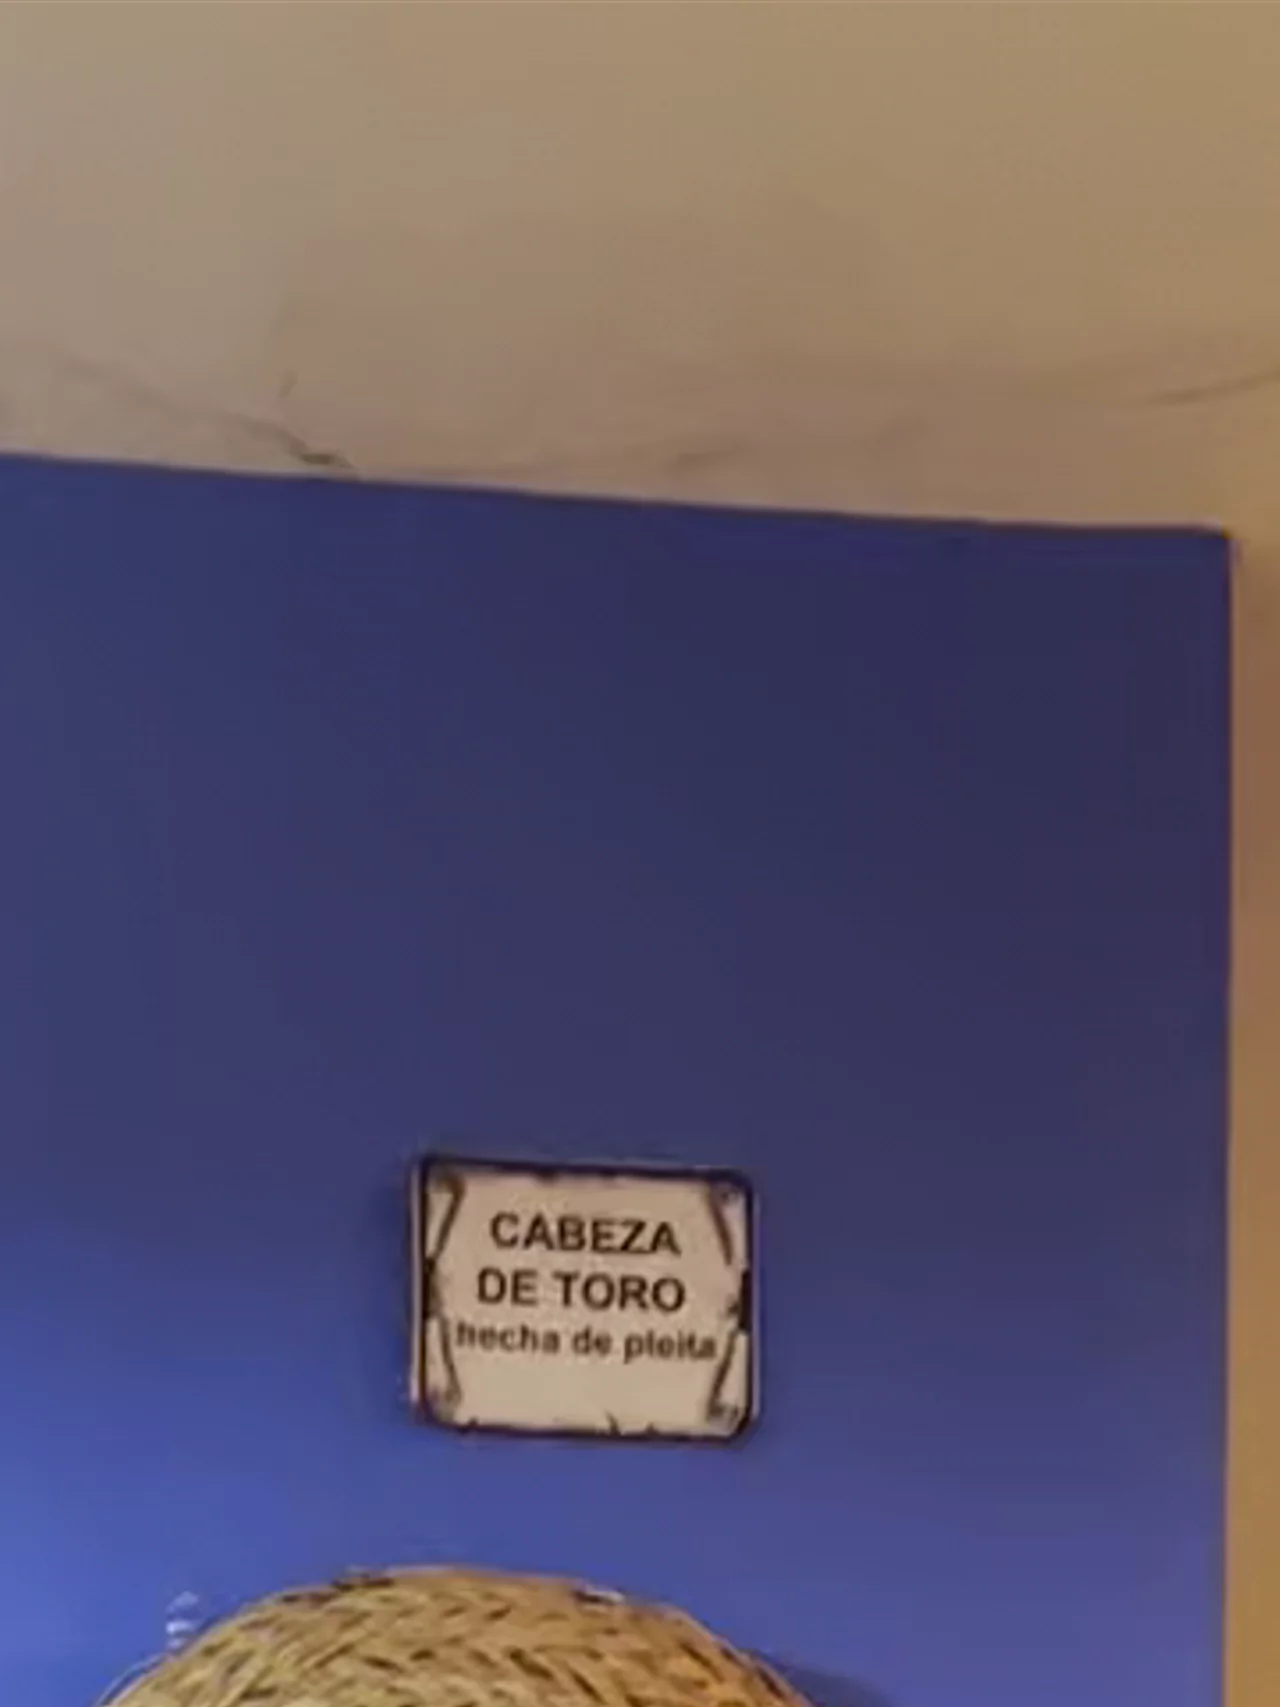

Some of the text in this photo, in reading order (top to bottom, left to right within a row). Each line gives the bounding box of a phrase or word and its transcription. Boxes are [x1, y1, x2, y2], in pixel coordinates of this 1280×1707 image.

[488, 1211, 682, 1256] CABEZA
[476, 1266, 686, 1314] DE TORO
[455, 1322, 717, 1364] hecha de pleita
